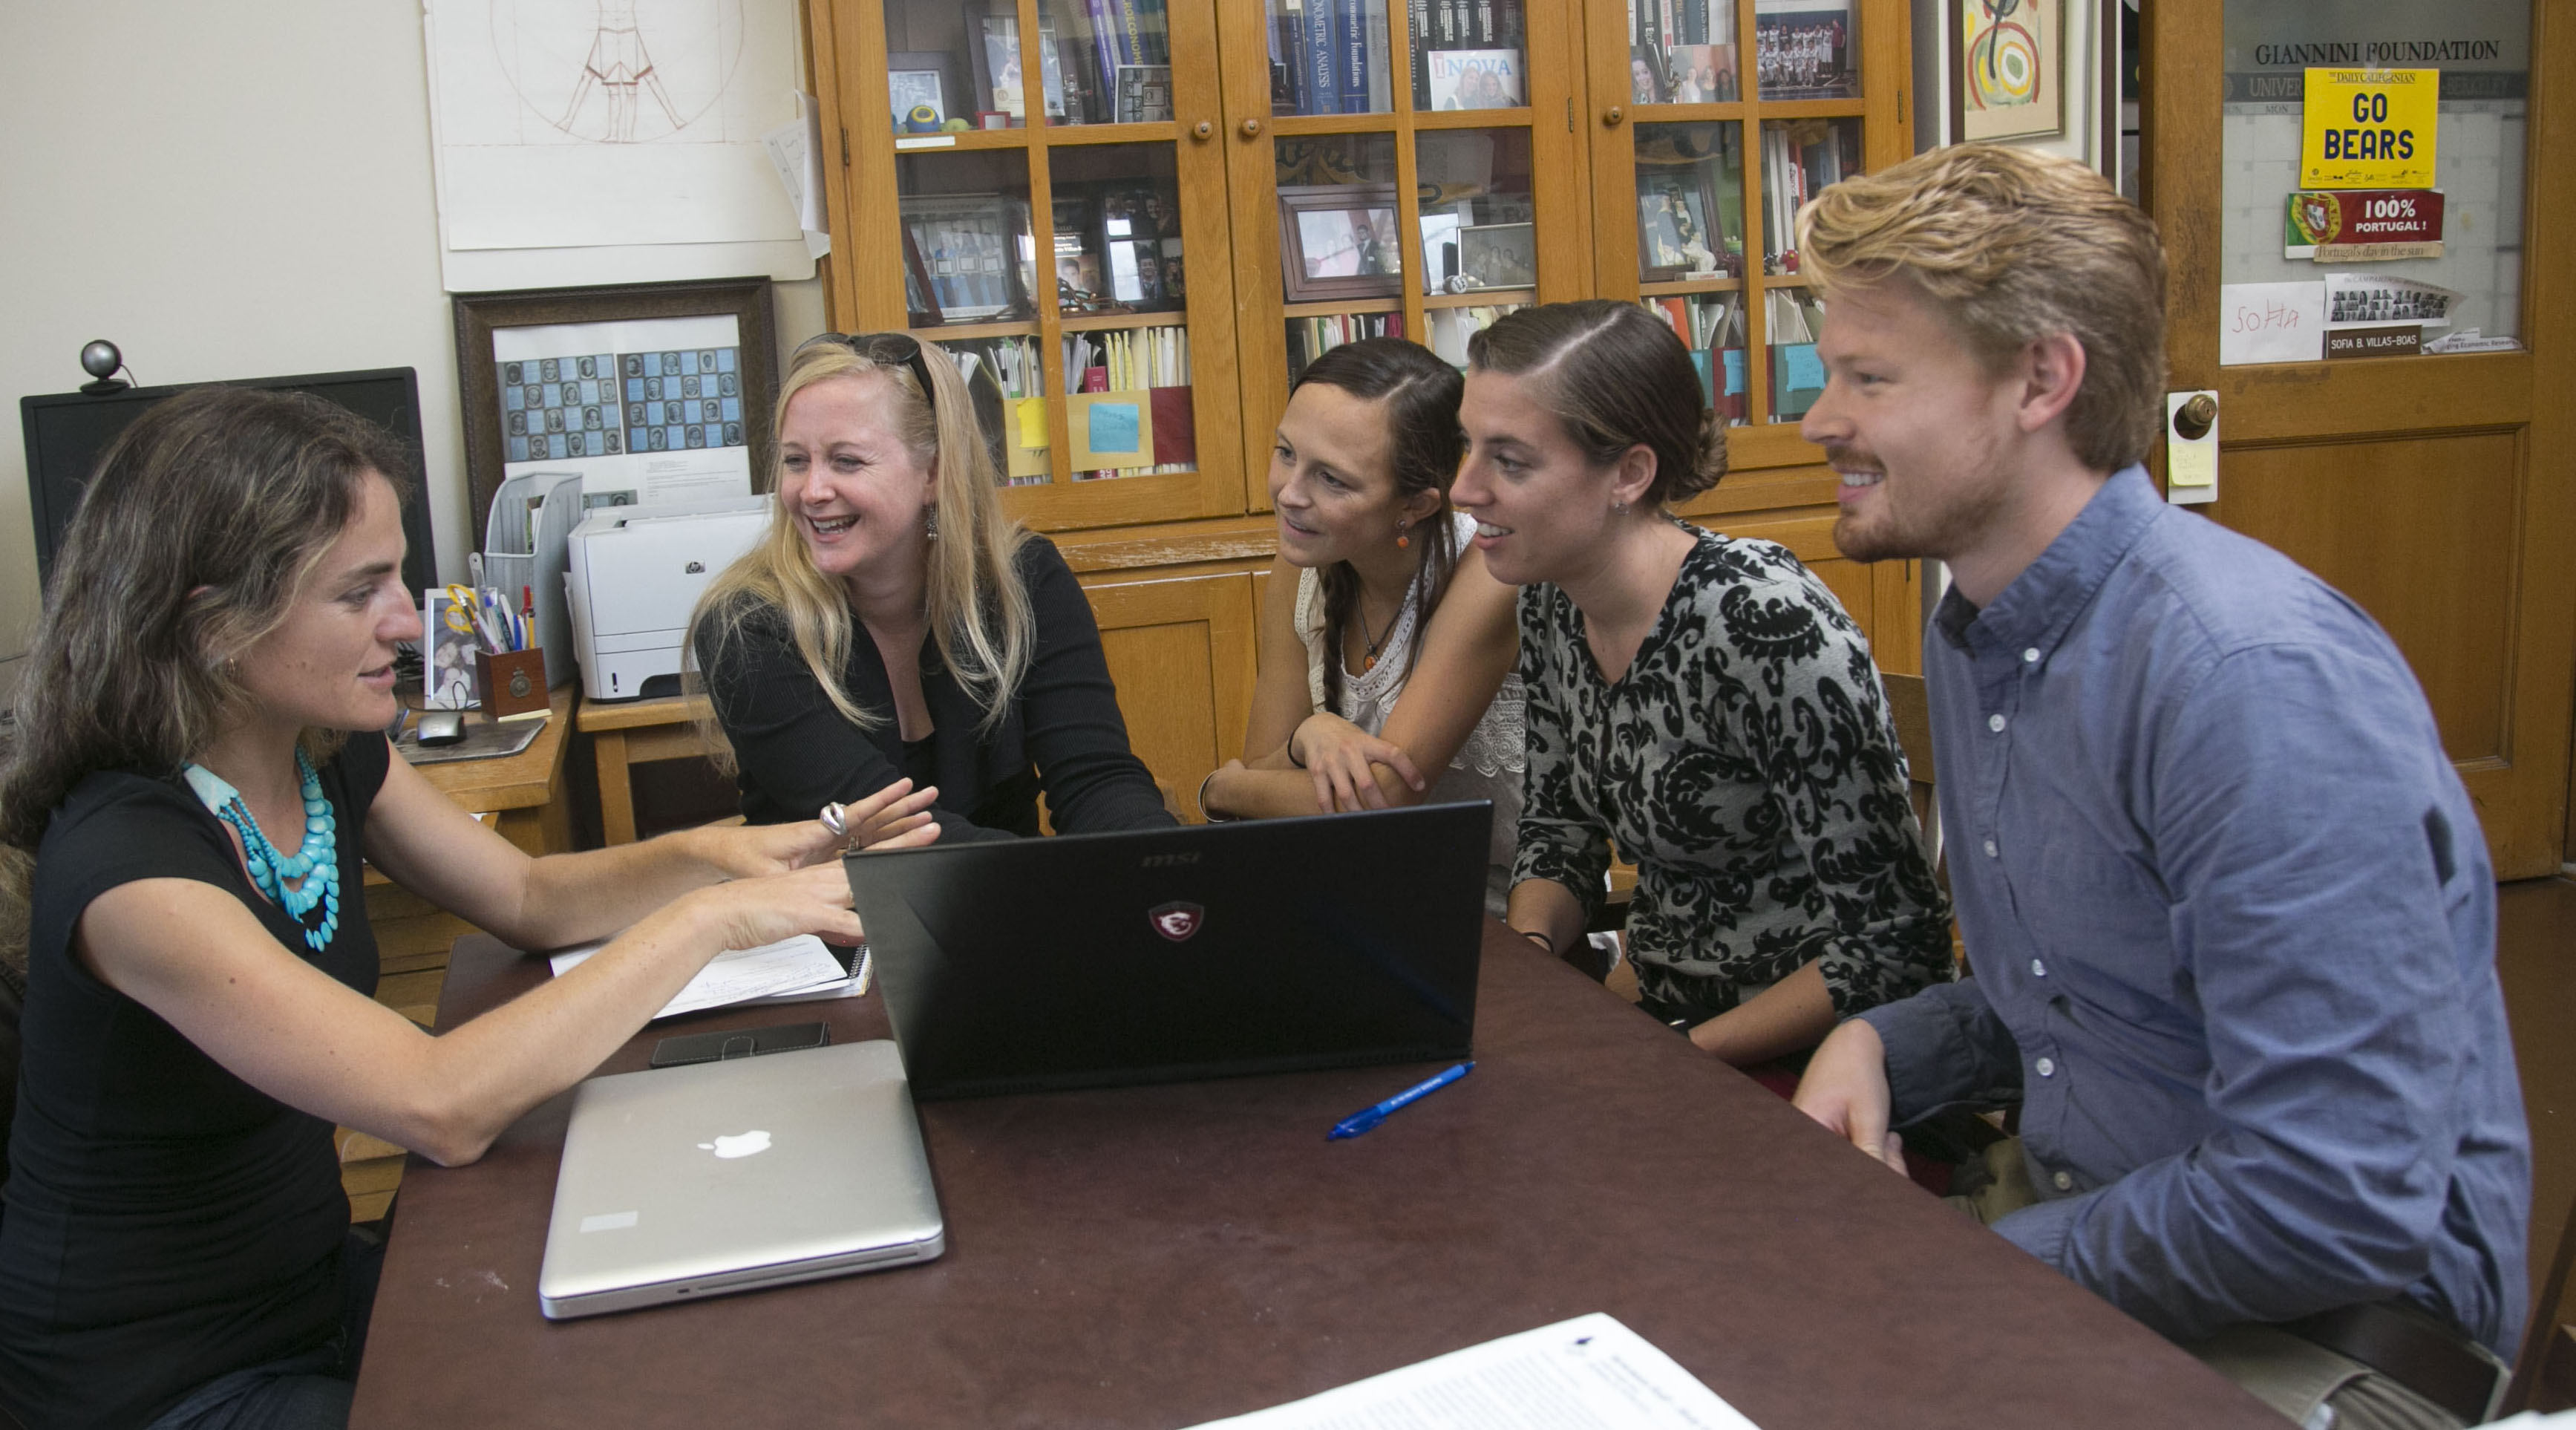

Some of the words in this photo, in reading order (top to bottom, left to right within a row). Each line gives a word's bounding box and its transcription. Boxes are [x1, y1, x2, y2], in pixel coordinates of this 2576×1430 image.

[2255, 43, 2358, 65] GIANNINI
[2366, 39, 2500, 62] FOUNDATION
[1316, 50, 1330, 88] ANALYSIS
[1350, 42, 1363, 88] Foundations
[2337, 72, 2361, 83] DAILY
[2353, 94, 2388, 123] GO
[2324, 129, 2414, 160] BEARS
[2365, 199, 2416, 219] 100%
[2356, 221, 2419, 233] PORTUGAL
[2318, 245, 2361, 258] Portugal's
[2380, 246, 2389, 255] in
[2390, 245, 2406, 255] the
[2407, 247, 2424, 255] sun
[2331, 339, 2353, 350] SOFIA
[2366, 335, 2417, 347] VILLAS-BOAS
